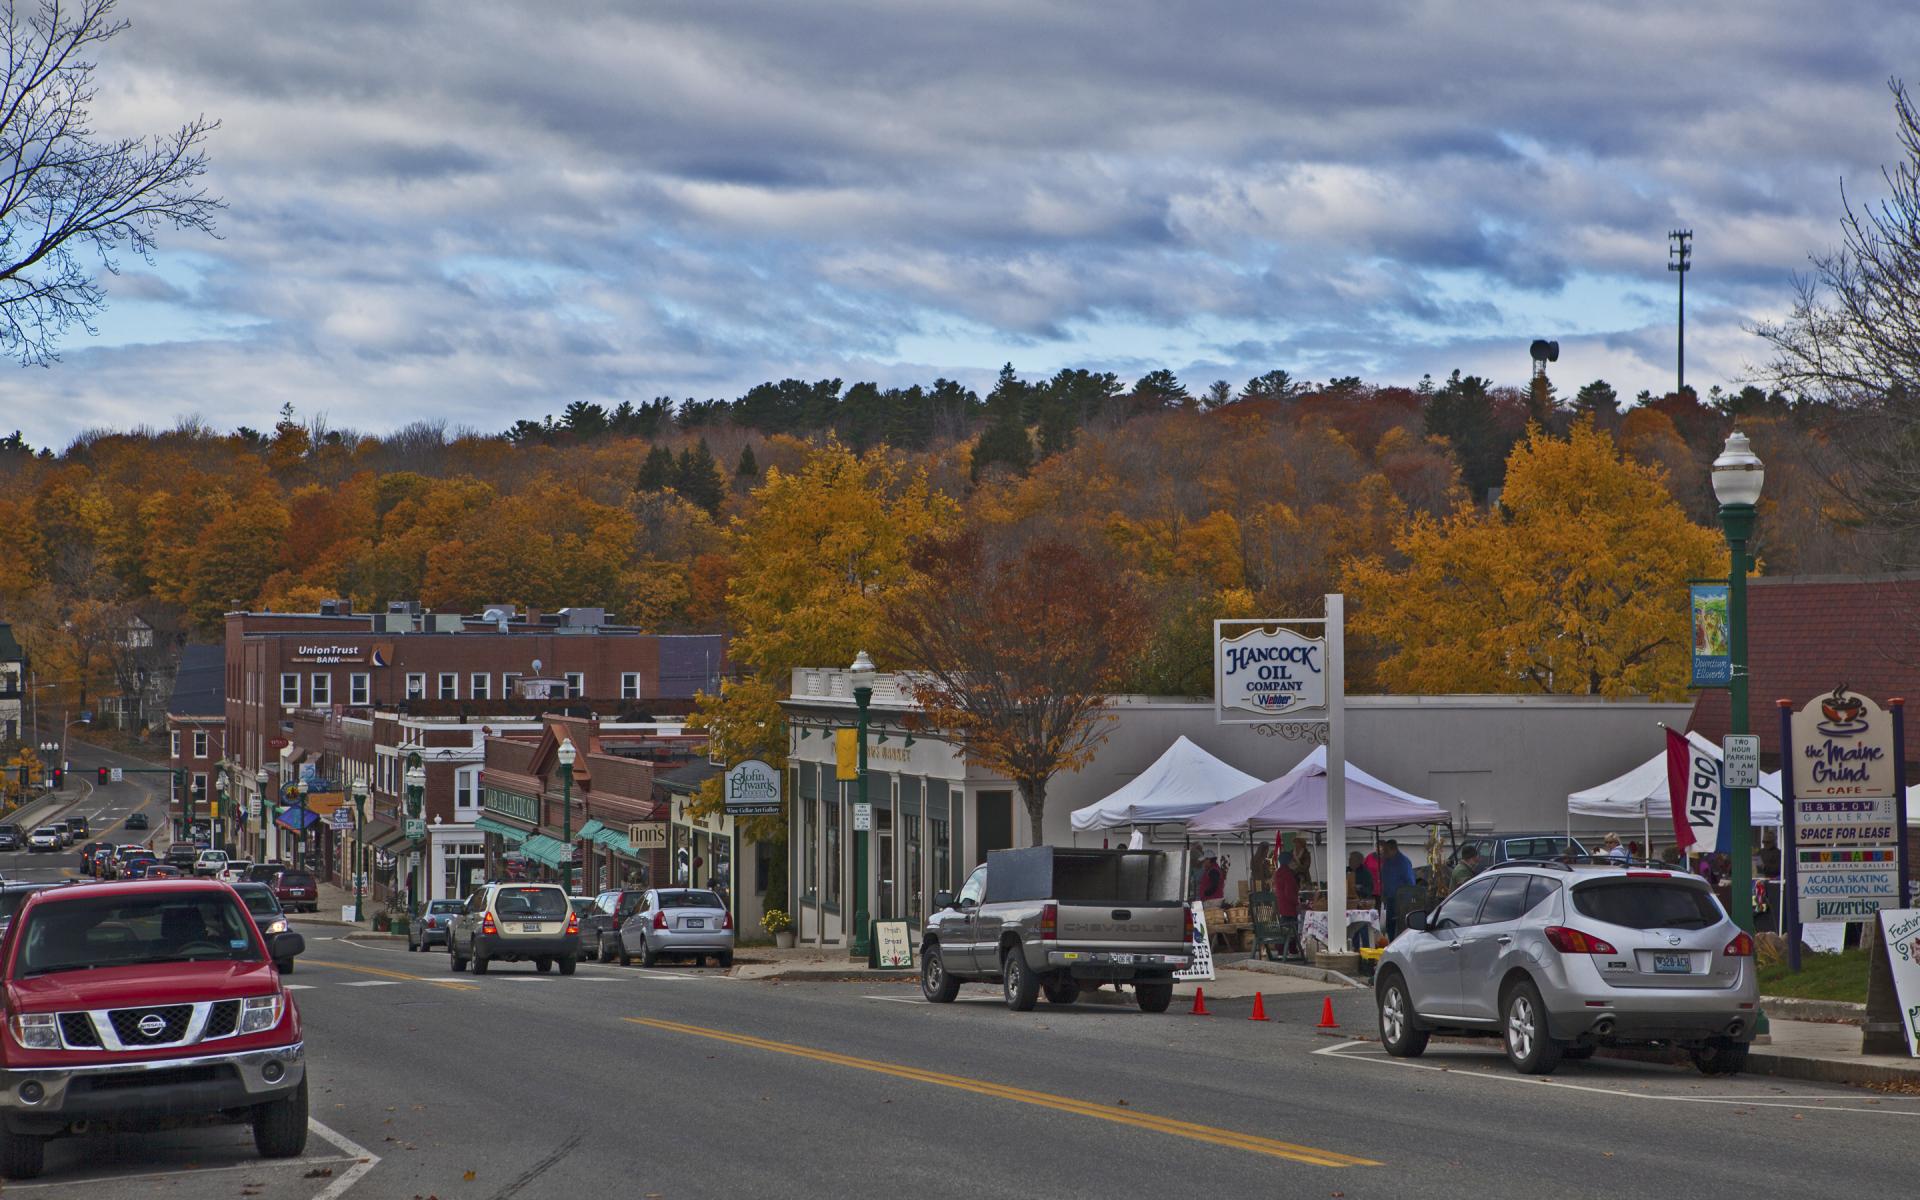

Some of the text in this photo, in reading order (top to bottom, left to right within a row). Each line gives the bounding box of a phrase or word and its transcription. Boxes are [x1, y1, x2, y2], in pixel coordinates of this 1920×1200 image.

[1226, 646, 1321, 675] HANCOCK
[1695, 658, 1727, 671] Downtown
[1258, 665, 1292, 680] OIL
[1246, 681, 1303, 691] COMPANY
[1258, 694, 1291, 705] Webber
[1805, 739, 1884, 765] the Maine
[1813, 761, 1870, 784] Grind
[730, 777, 777, 799] Edwards
[1827, 786, 1862, 794] CAFE
[1803, 813, 1872, 822] GALLERY
[630, 825, 664, 842] finn's
[1801, 828, 1890, 839] SPACE FOR LEASE
[1808, 874, 1888, 884] ACADIA SKATING
[1874, 884, 1893, 893] INC.
[1816, 899, 1879, 919] jazzercise
[1064, 923, 1178, 933] CHEVROLET
